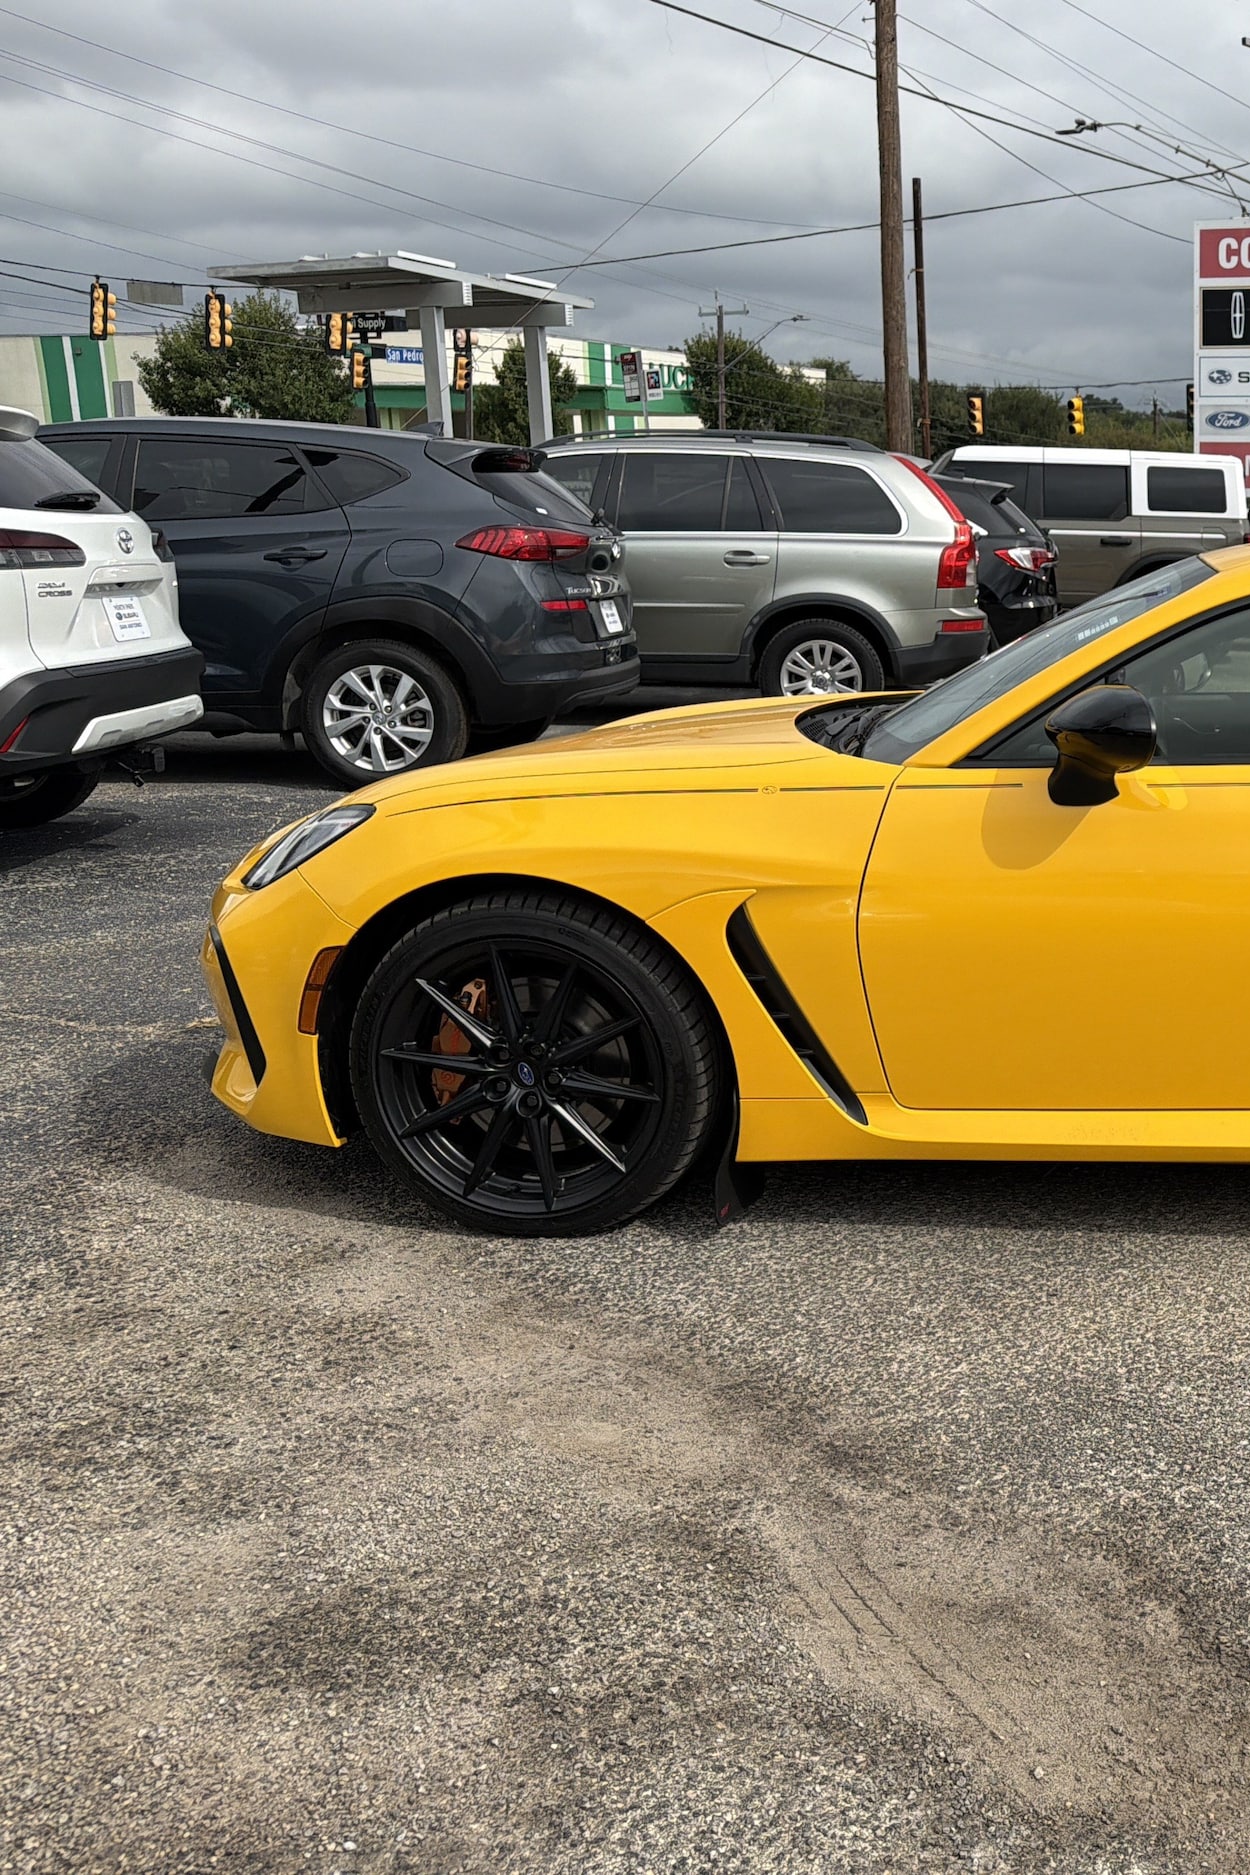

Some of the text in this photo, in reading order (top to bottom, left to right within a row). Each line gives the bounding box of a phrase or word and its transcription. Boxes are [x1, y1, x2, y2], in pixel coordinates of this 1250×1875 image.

[358, 317, 386, 331] Supply
[387, 348, 424, 362] San Pedro
[1214, 413, 1243, 428] Ford
